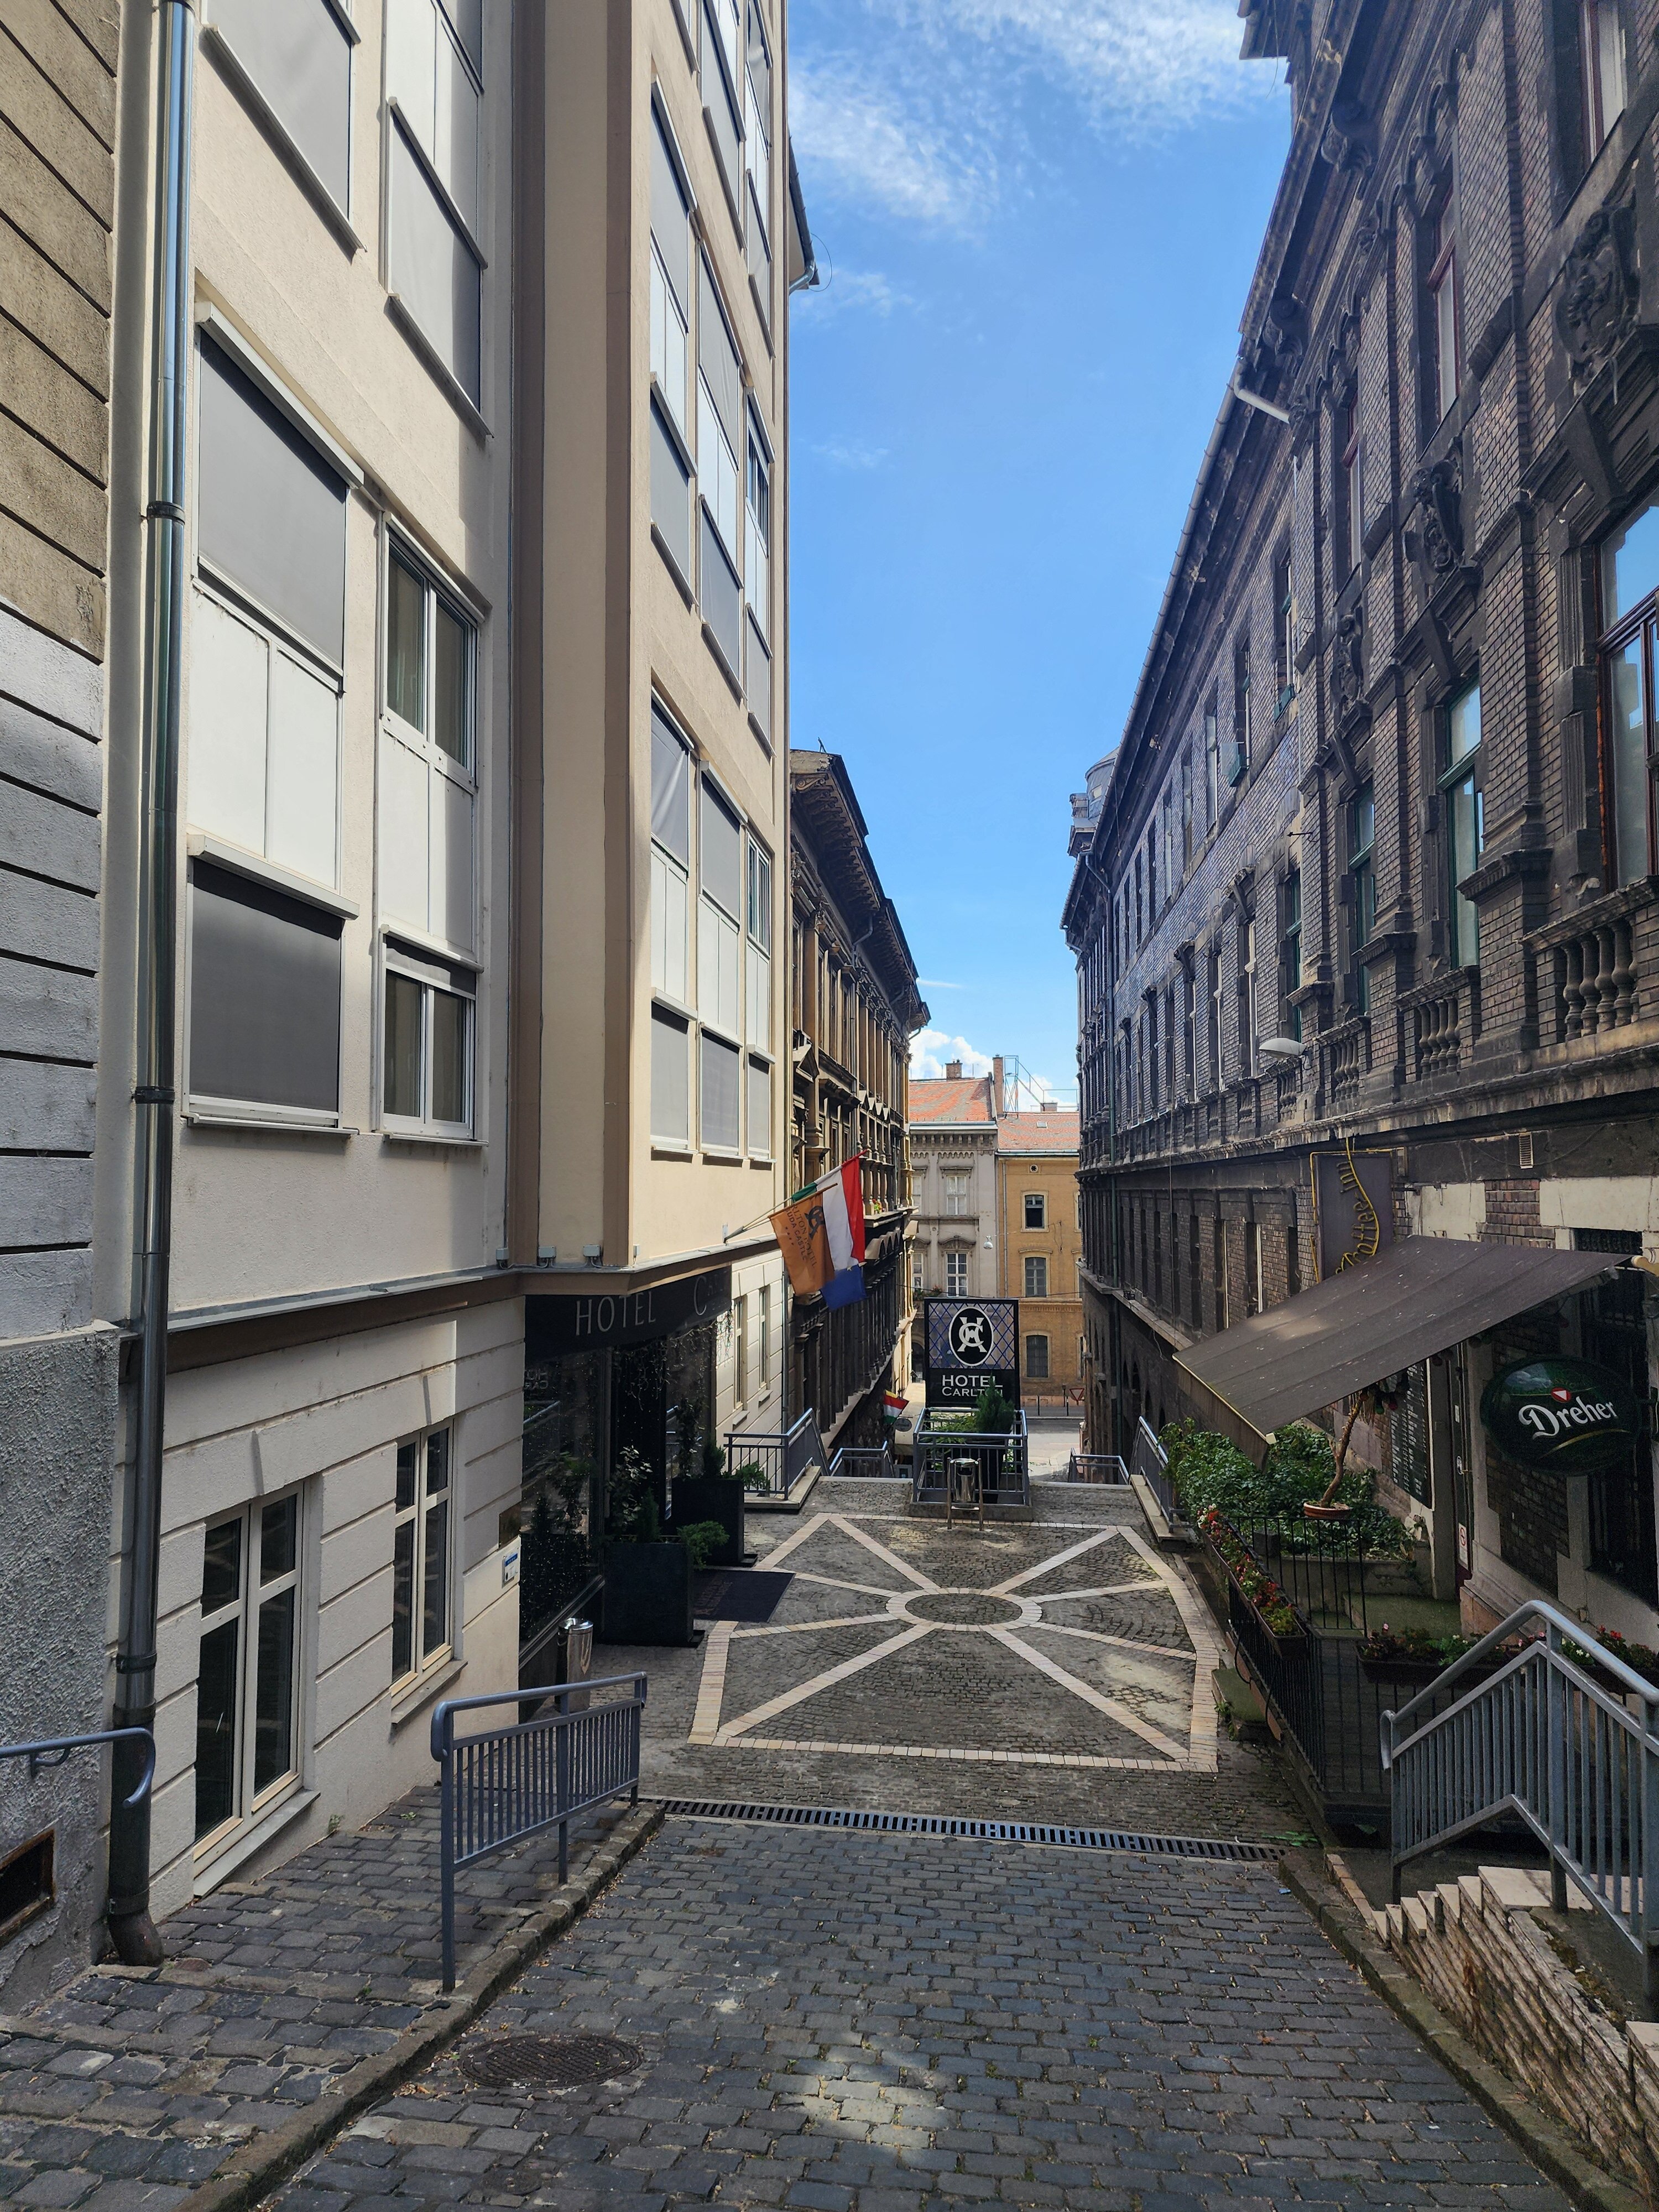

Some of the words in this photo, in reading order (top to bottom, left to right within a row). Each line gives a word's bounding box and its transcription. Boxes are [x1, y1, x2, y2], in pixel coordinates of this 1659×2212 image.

[794, 1229, 807, 1261] CASTLE
[576, 1291, 656, 1336] HOTEL
[942, 1375, 1003, 1387] HOTEL
[942, 1386, 1003, 1397] CARLTN
[1518, 1396, 1619, 1438] Dreher
